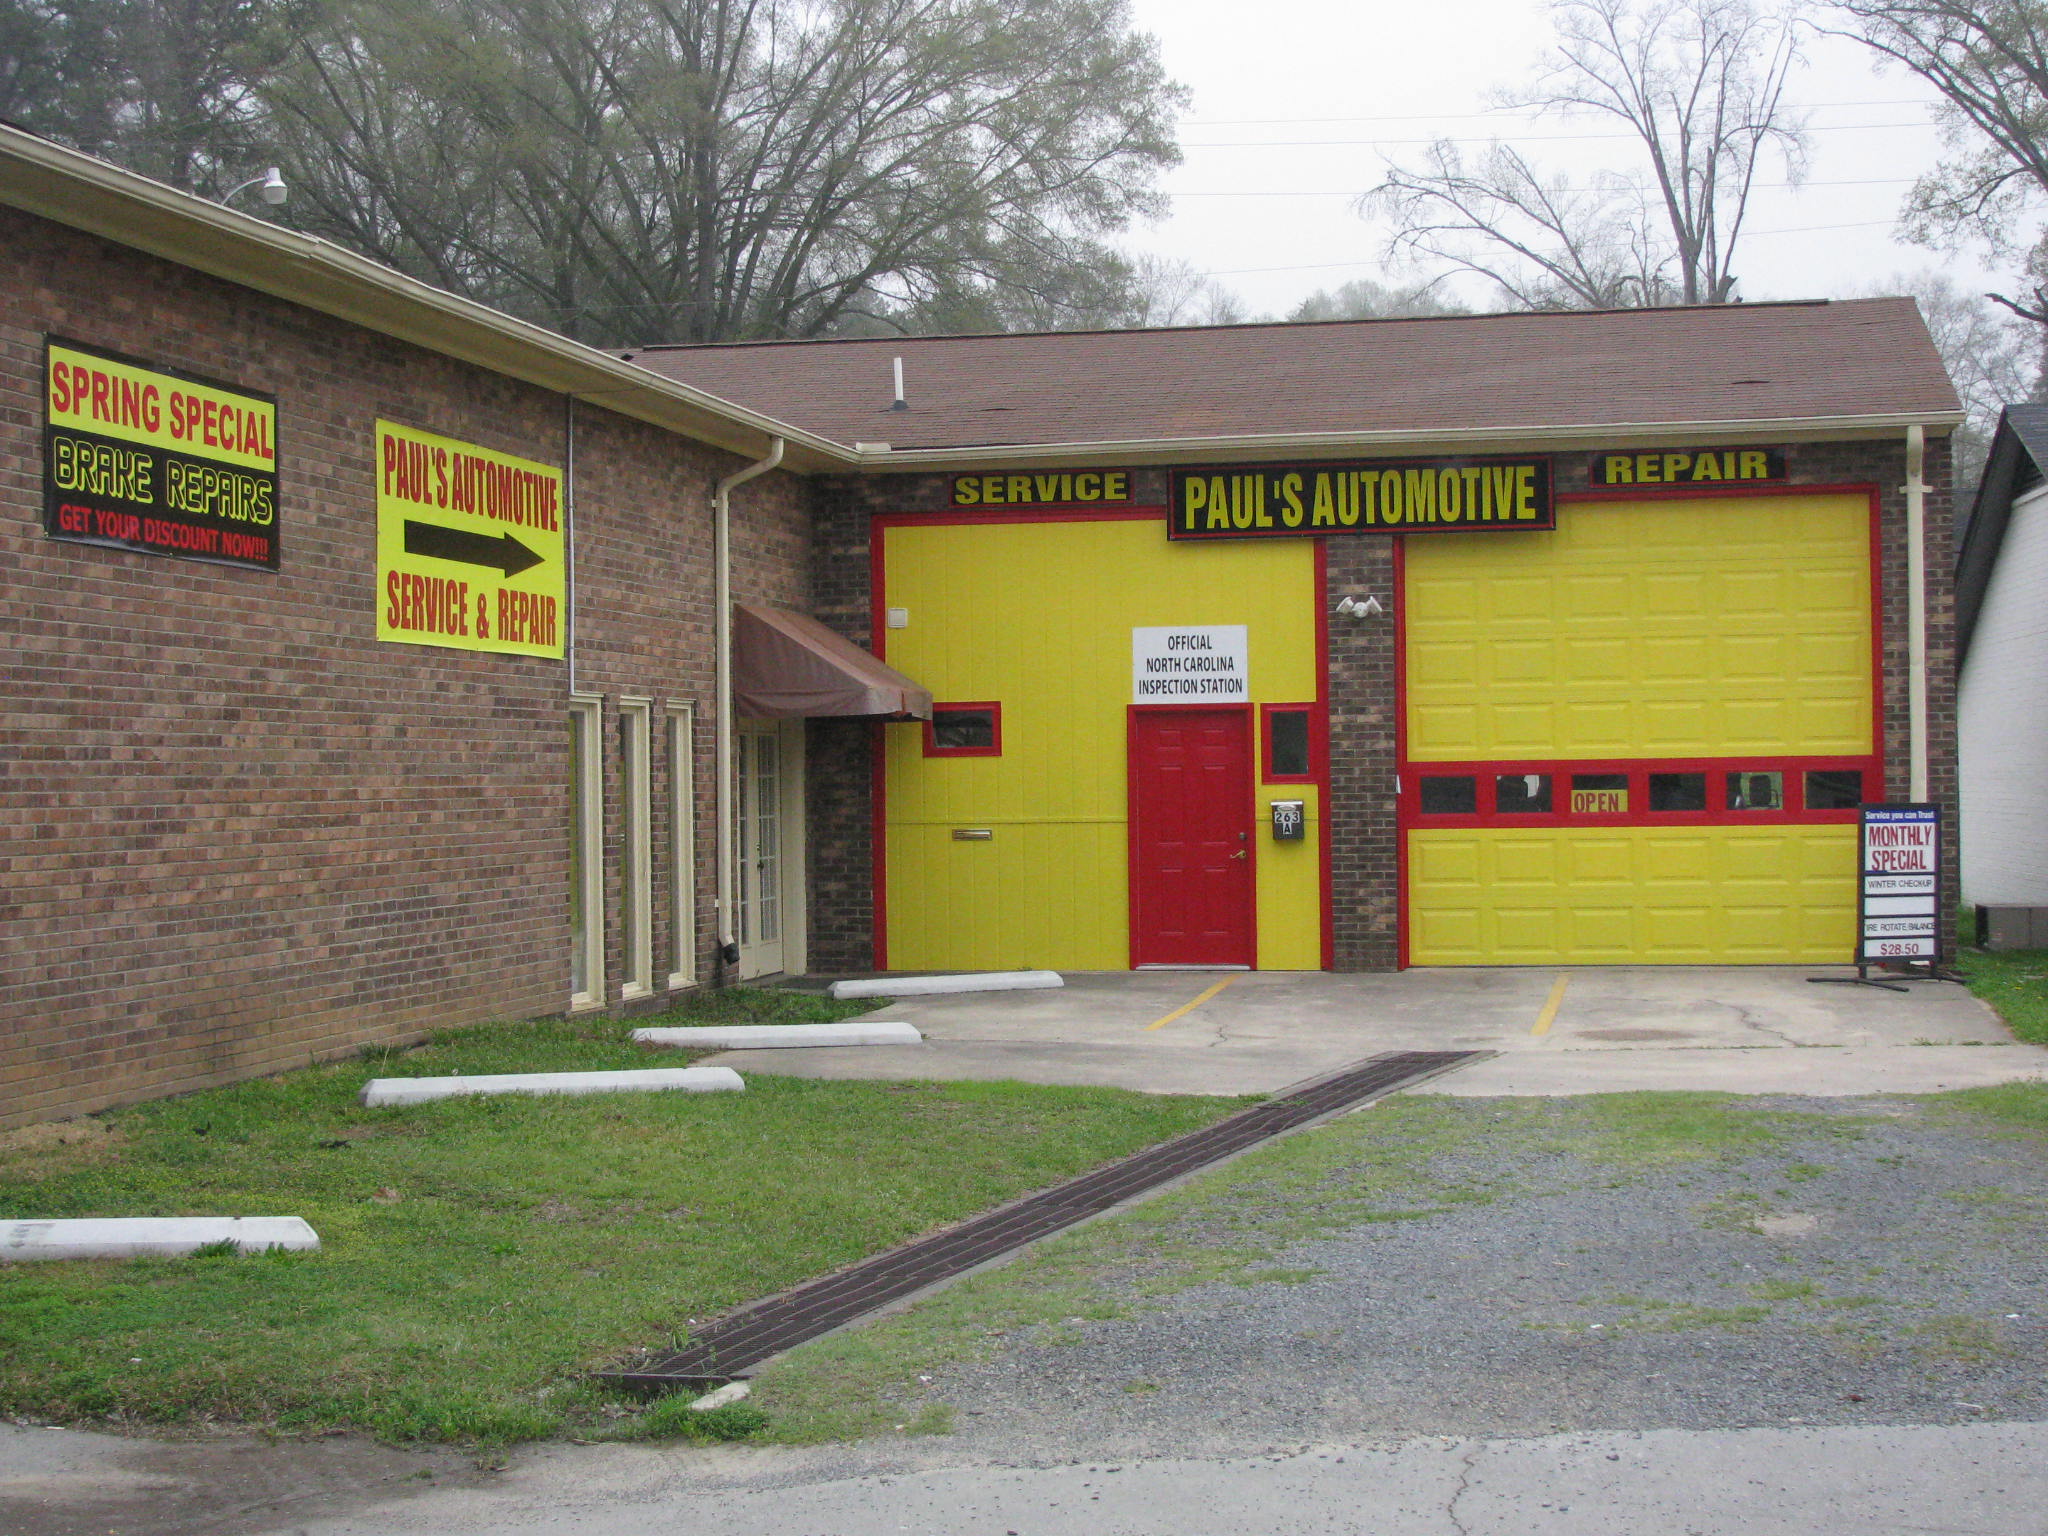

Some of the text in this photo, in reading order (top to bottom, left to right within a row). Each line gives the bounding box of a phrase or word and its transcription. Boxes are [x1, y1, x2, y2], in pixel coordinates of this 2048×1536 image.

[52, 361, 273, 460] SPRING SPECIAL
[1605, 451, 1768, 484] REPAIR
[54, 436, 273, 526] BRAKE REPAIRS
[384, 433, 558, 532] PAUL'S AUTOMOTIVE
[955, 472, 1127, 504] SERVICE
[1185, 466, 1536, 529] PAUL'S AUTOMOTIVE
[59, 503, 268, 561] GET YOUR DISCOUNT NOW!!!
[387, 570, 557, 646] SERVICE & REPAIR
[1167, 635, 1213, 650] OFFICIAL
[1146, 656, 1234, 673] NORTH CAROLINA
[1138, 678, 1243, 695] INSPECTION STATION
[1574, 792, 1619, 812] OPEN
[1275, 812, 1299, 823] 263
[1865, 811, 1890, 820] Service
[1891, 812, 1904, 820] you
[1918, 811, 1935, 819] Trust
[1284, 824, 1291, 833] A
[1868, 825, 1932, 847] MONTHLY
[1871, 849, 1927, 872] SPECIAL
[1868, 879, 1932, 889] WINTER CHECKUP
[1866, 922, 1936, 932] IRE ROTATE BALANCE
[1880, 943, 1919, 956] $28.50
